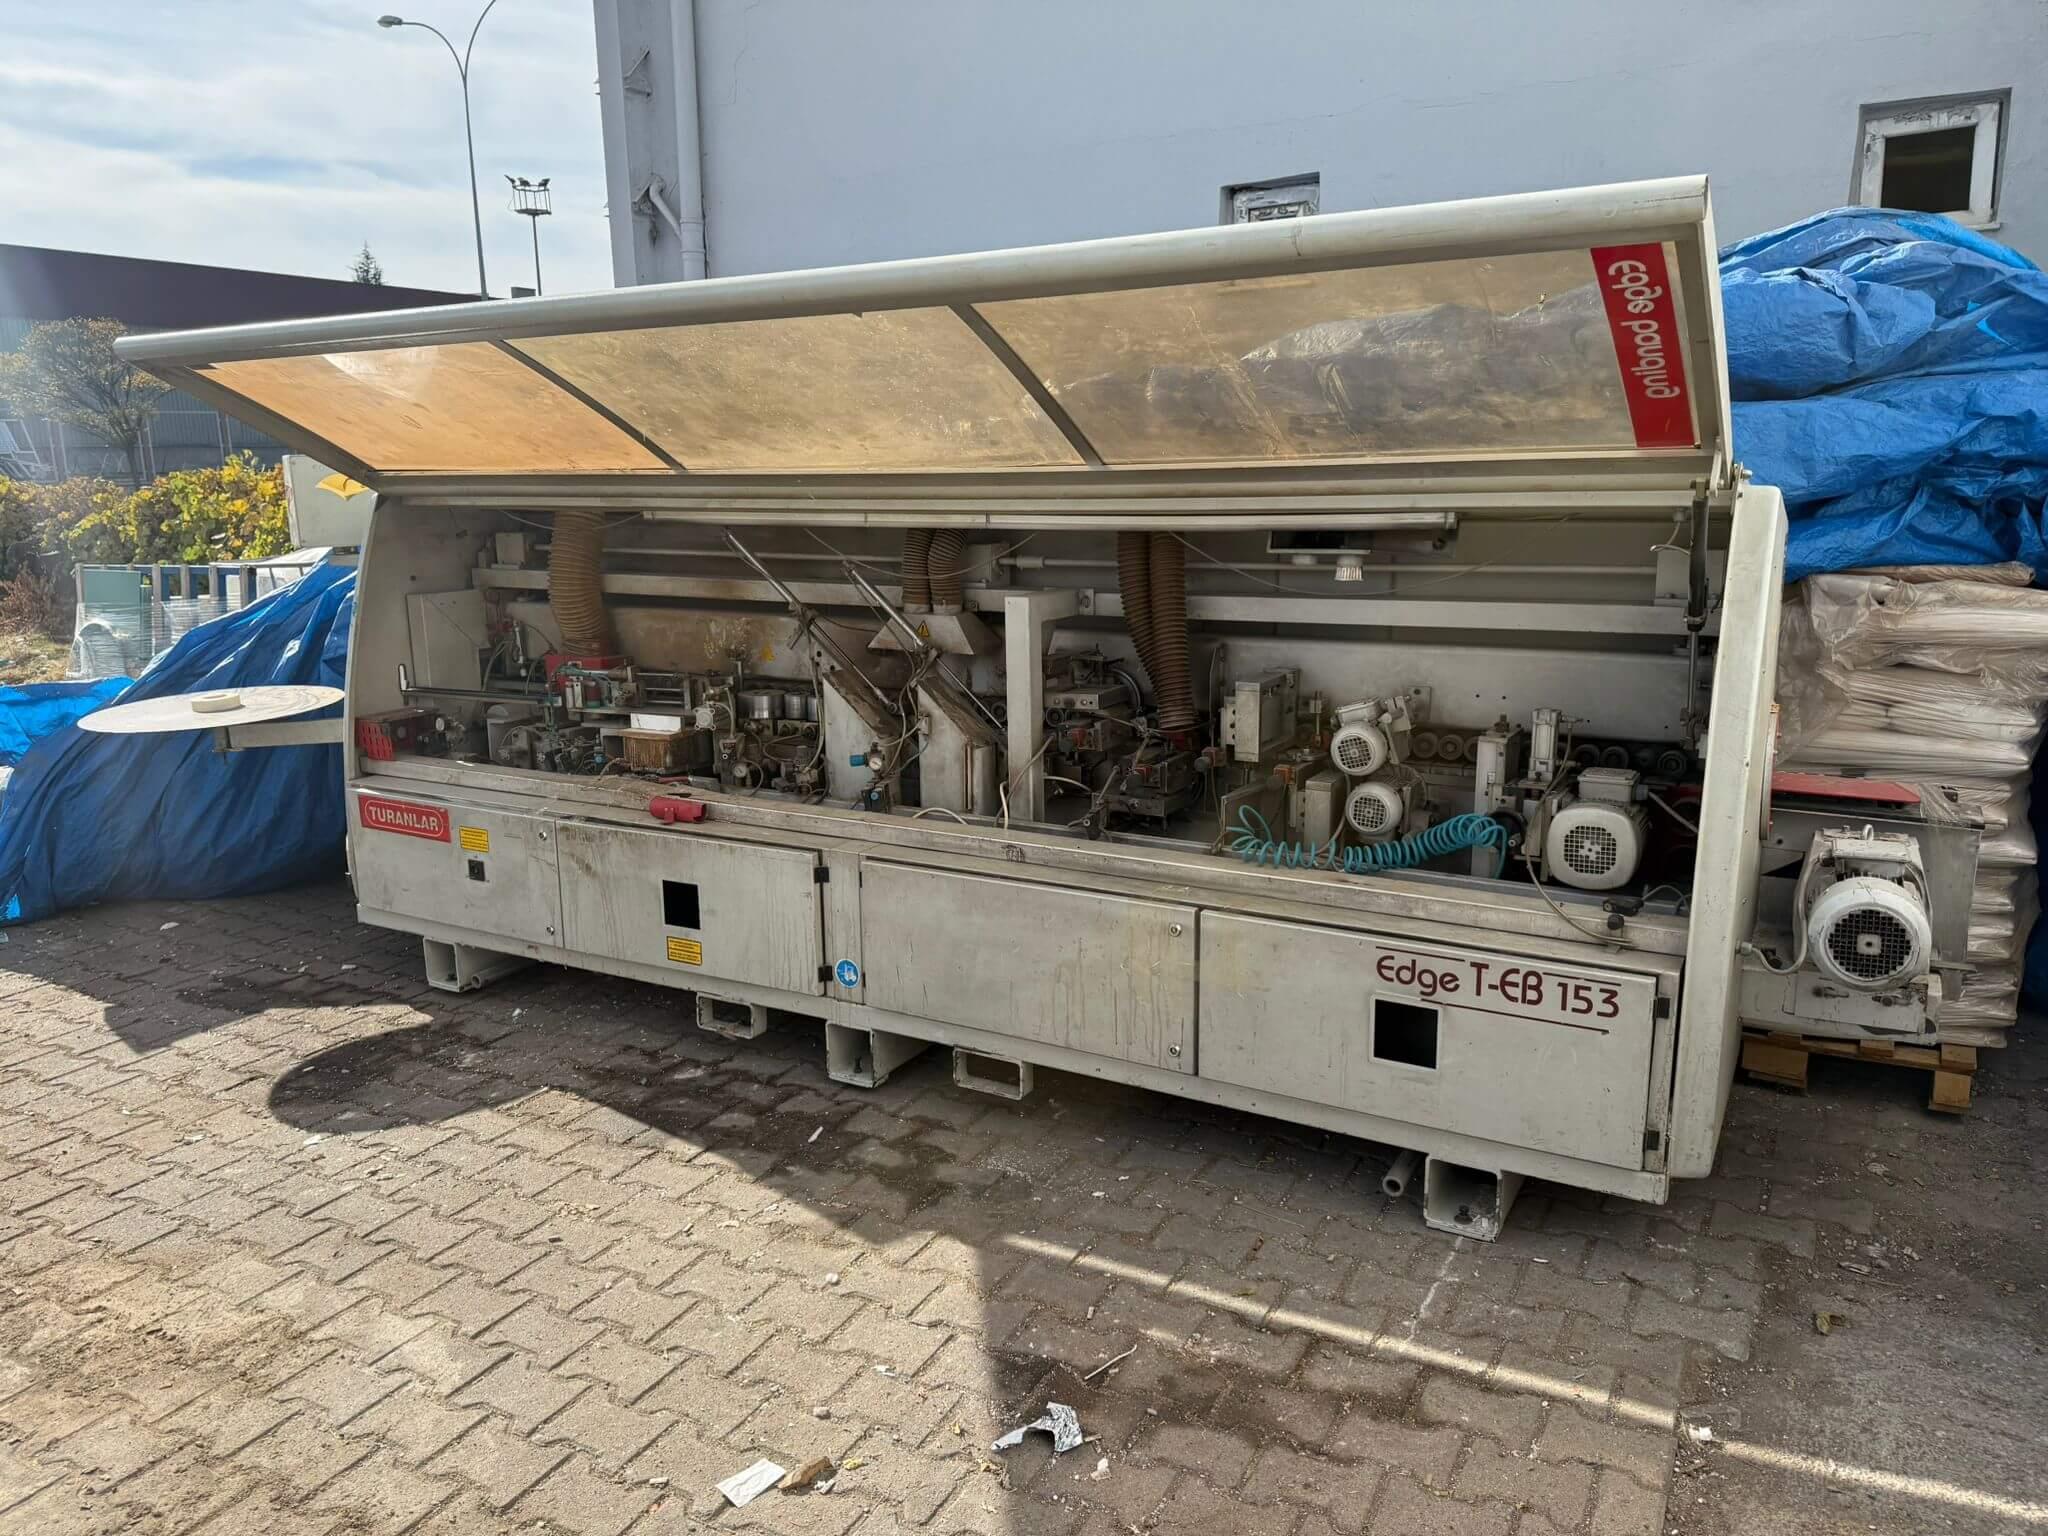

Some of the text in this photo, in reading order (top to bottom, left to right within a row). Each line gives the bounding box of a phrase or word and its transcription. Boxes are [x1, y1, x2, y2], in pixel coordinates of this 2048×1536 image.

[368, 806, 439, 831] TURANLAR
[1376, 955, 1620, 1018] Edge T-EB 153
